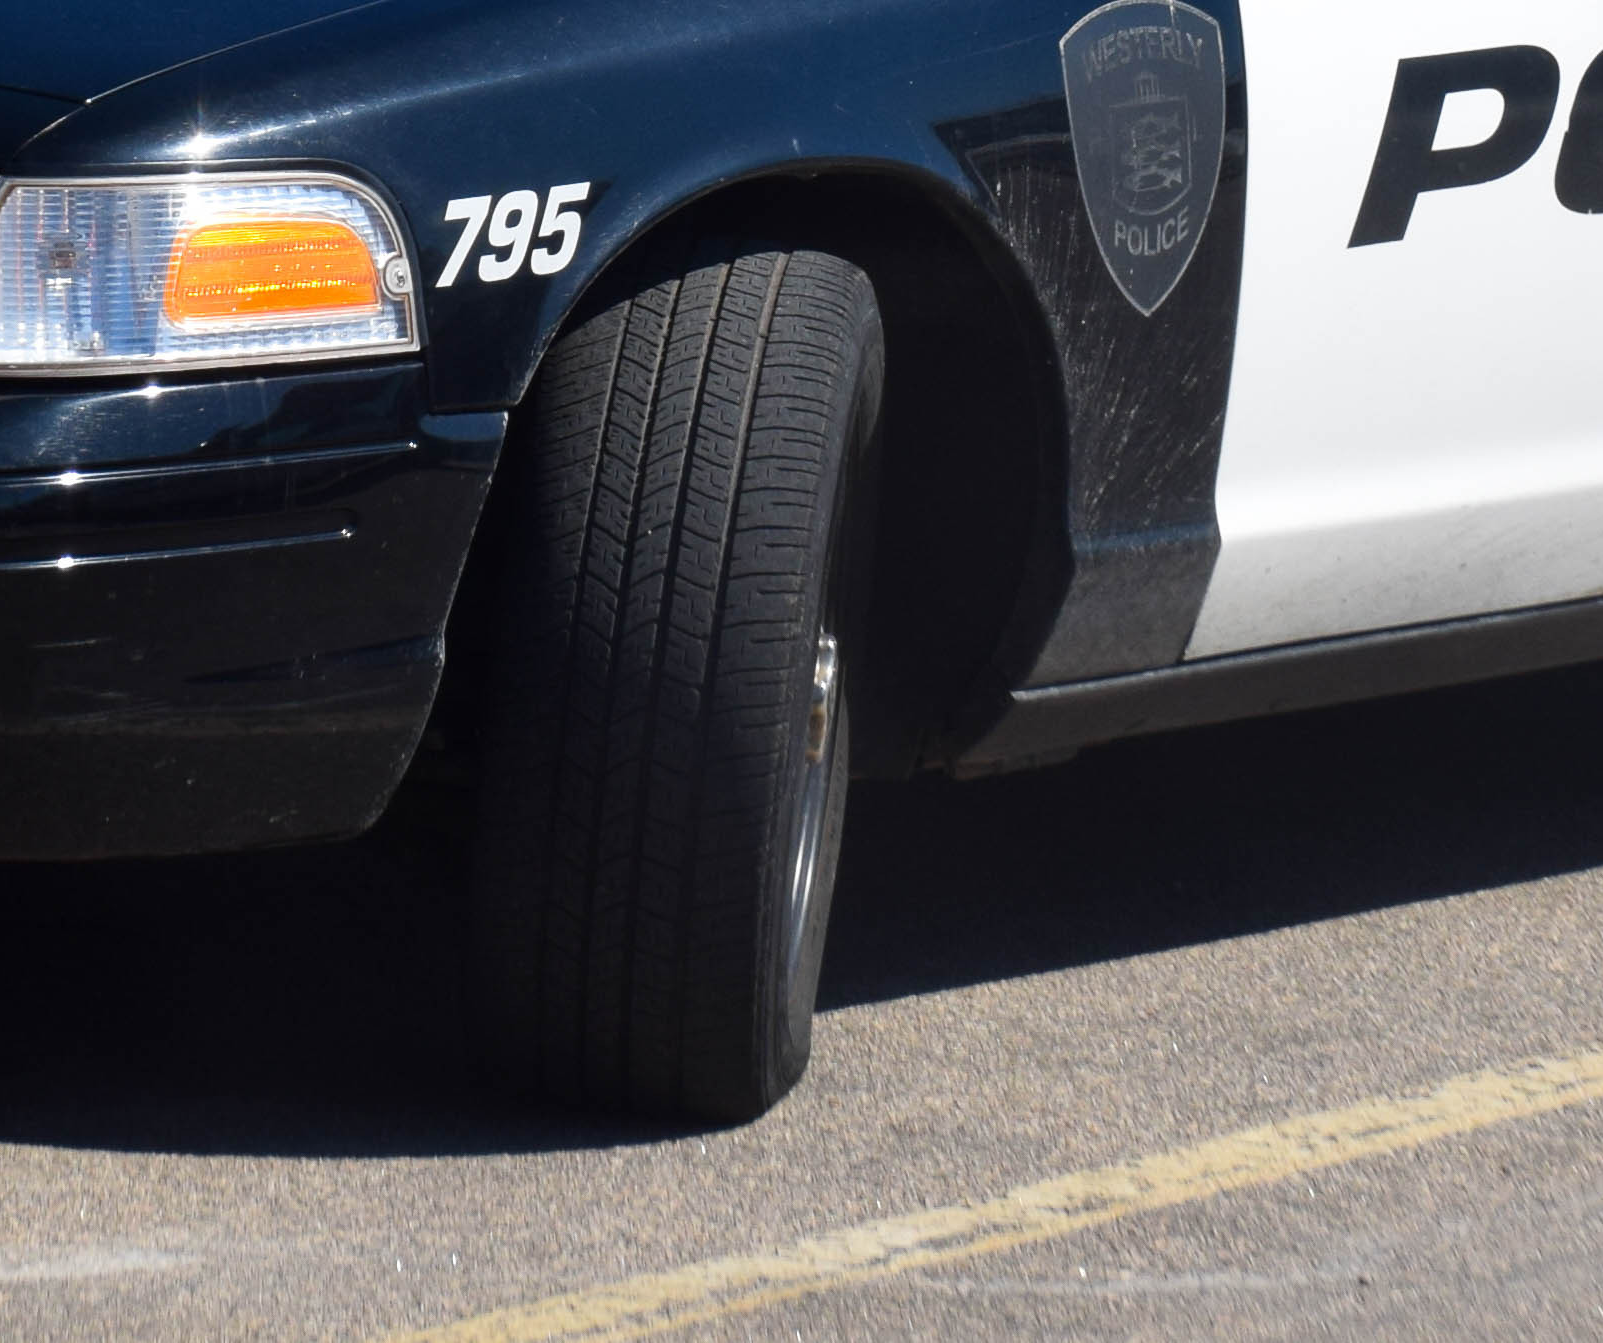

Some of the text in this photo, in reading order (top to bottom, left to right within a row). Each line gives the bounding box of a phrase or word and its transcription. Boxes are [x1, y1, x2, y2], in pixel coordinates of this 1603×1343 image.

[1082, 25, 1204, 80] WESTERLY
[435, 182, 591, 288] 795
[1114, 207, 1188, 256] POLICE
